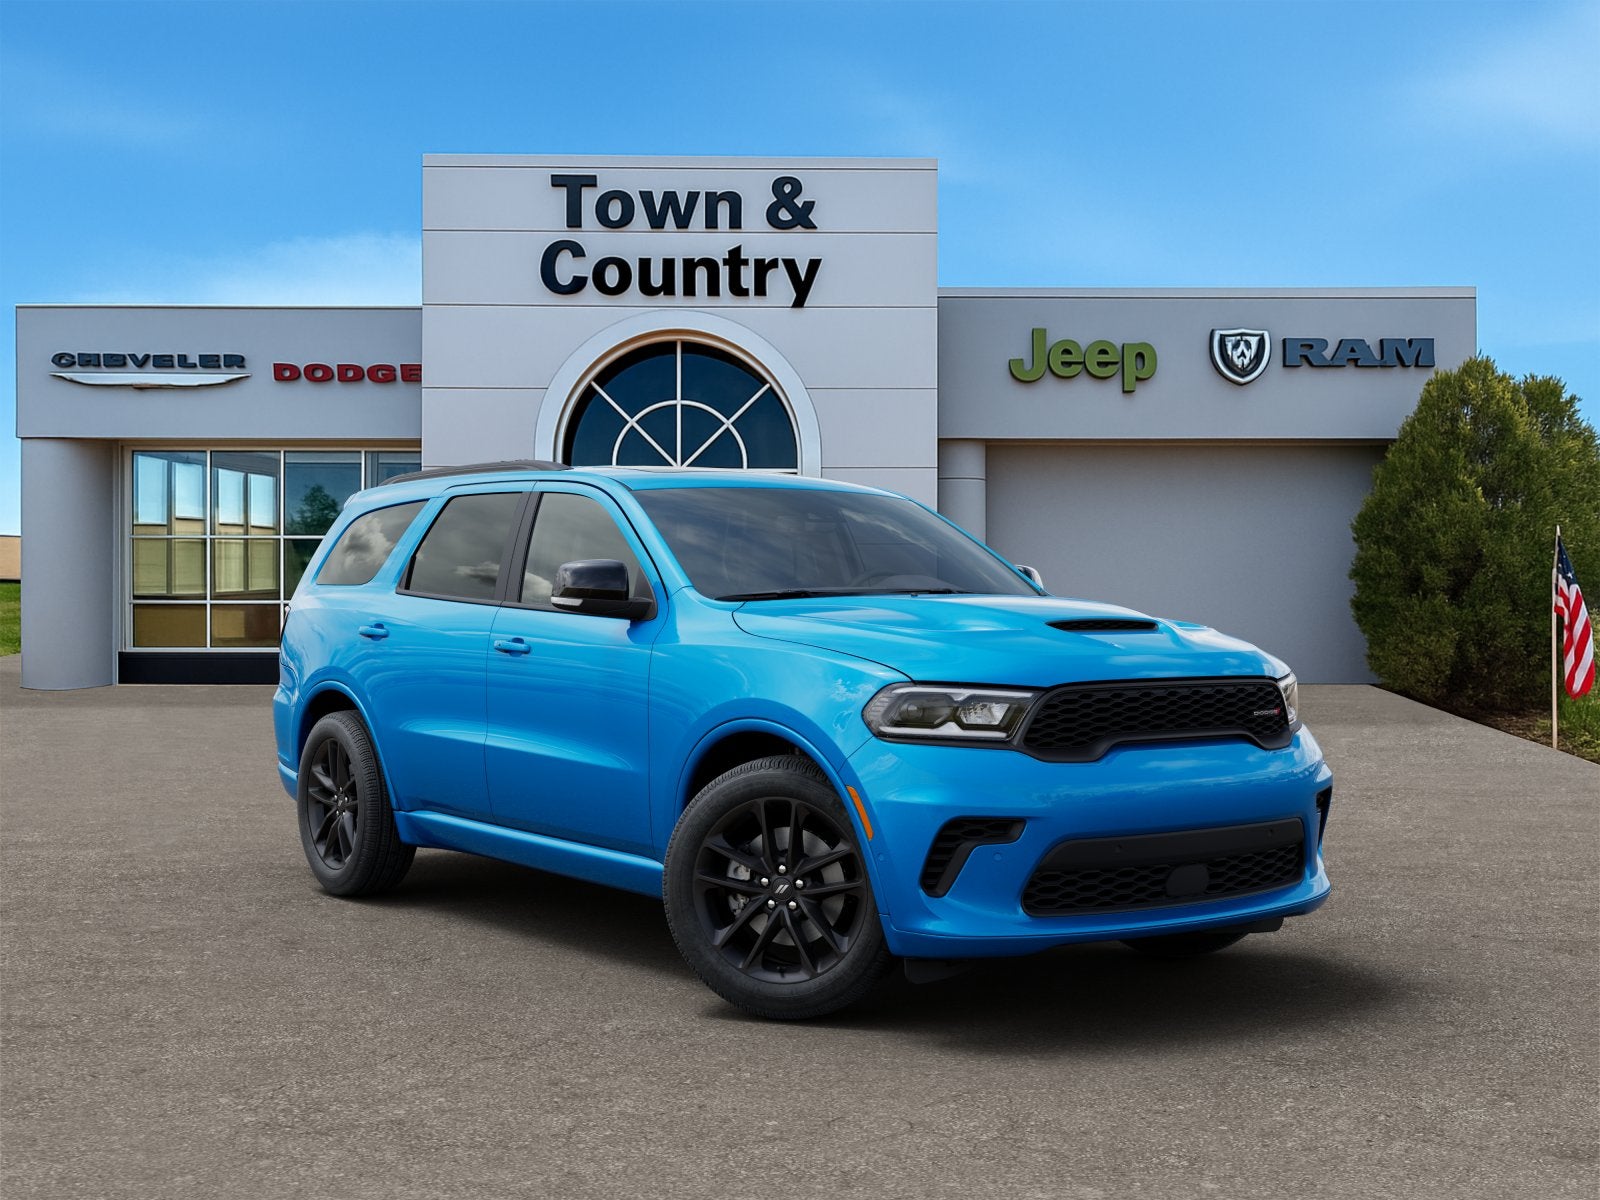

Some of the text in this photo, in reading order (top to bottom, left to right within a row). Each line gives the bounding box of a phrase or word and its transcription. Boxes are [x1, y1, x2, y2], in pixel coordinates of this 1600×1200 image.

[550, 174, 818, 230] Town &
[540, 239, 823, 308] Country
[273, 362, 422, 382] DODGE
[1009, 328, 1157, 393] Jeep
[1282, 337, 1436, 368] RAM
